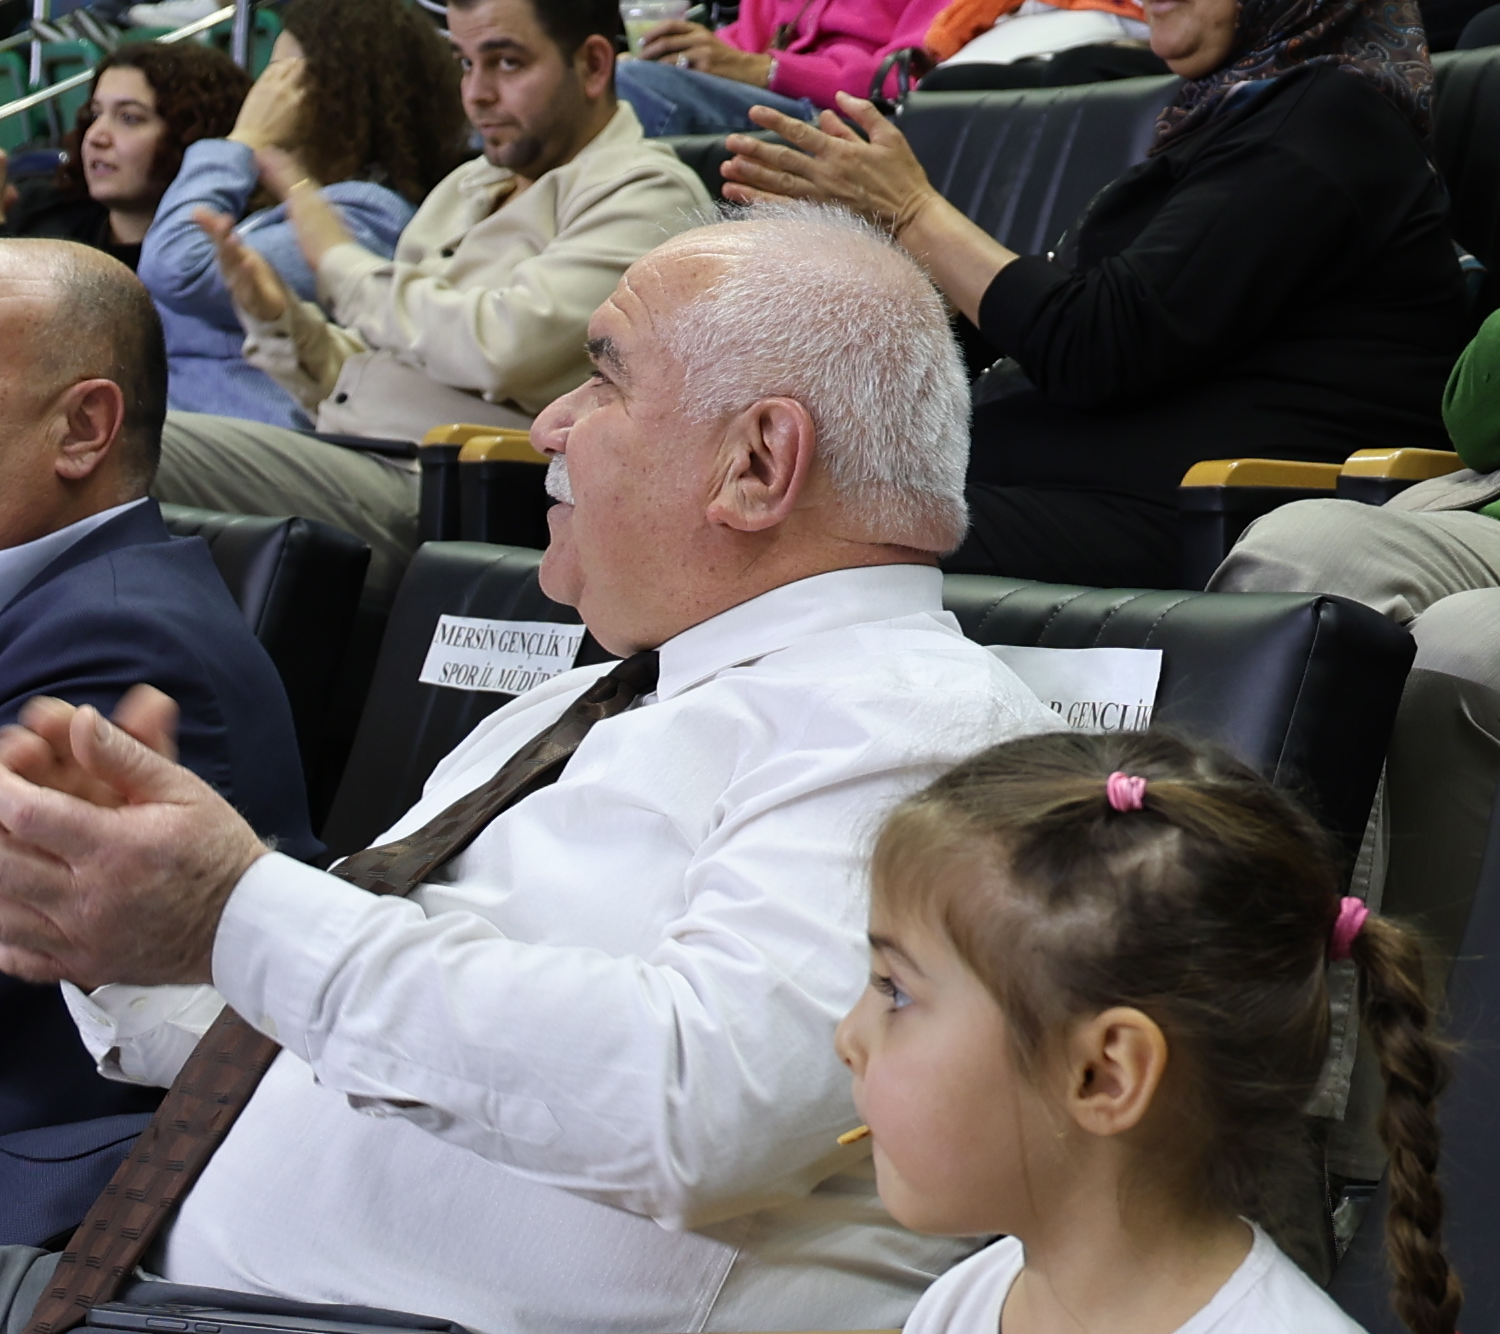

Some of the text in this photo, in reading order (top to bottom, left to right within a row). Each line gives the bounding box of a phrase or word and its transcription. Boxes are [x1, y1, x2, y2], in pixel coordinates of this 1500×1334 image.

[434, 623, 496, 651] MERSİN
[498, 629, 564, 660] GENÇLİK
[439, 661, 562, 692] SPOR İL MÜDÜ
